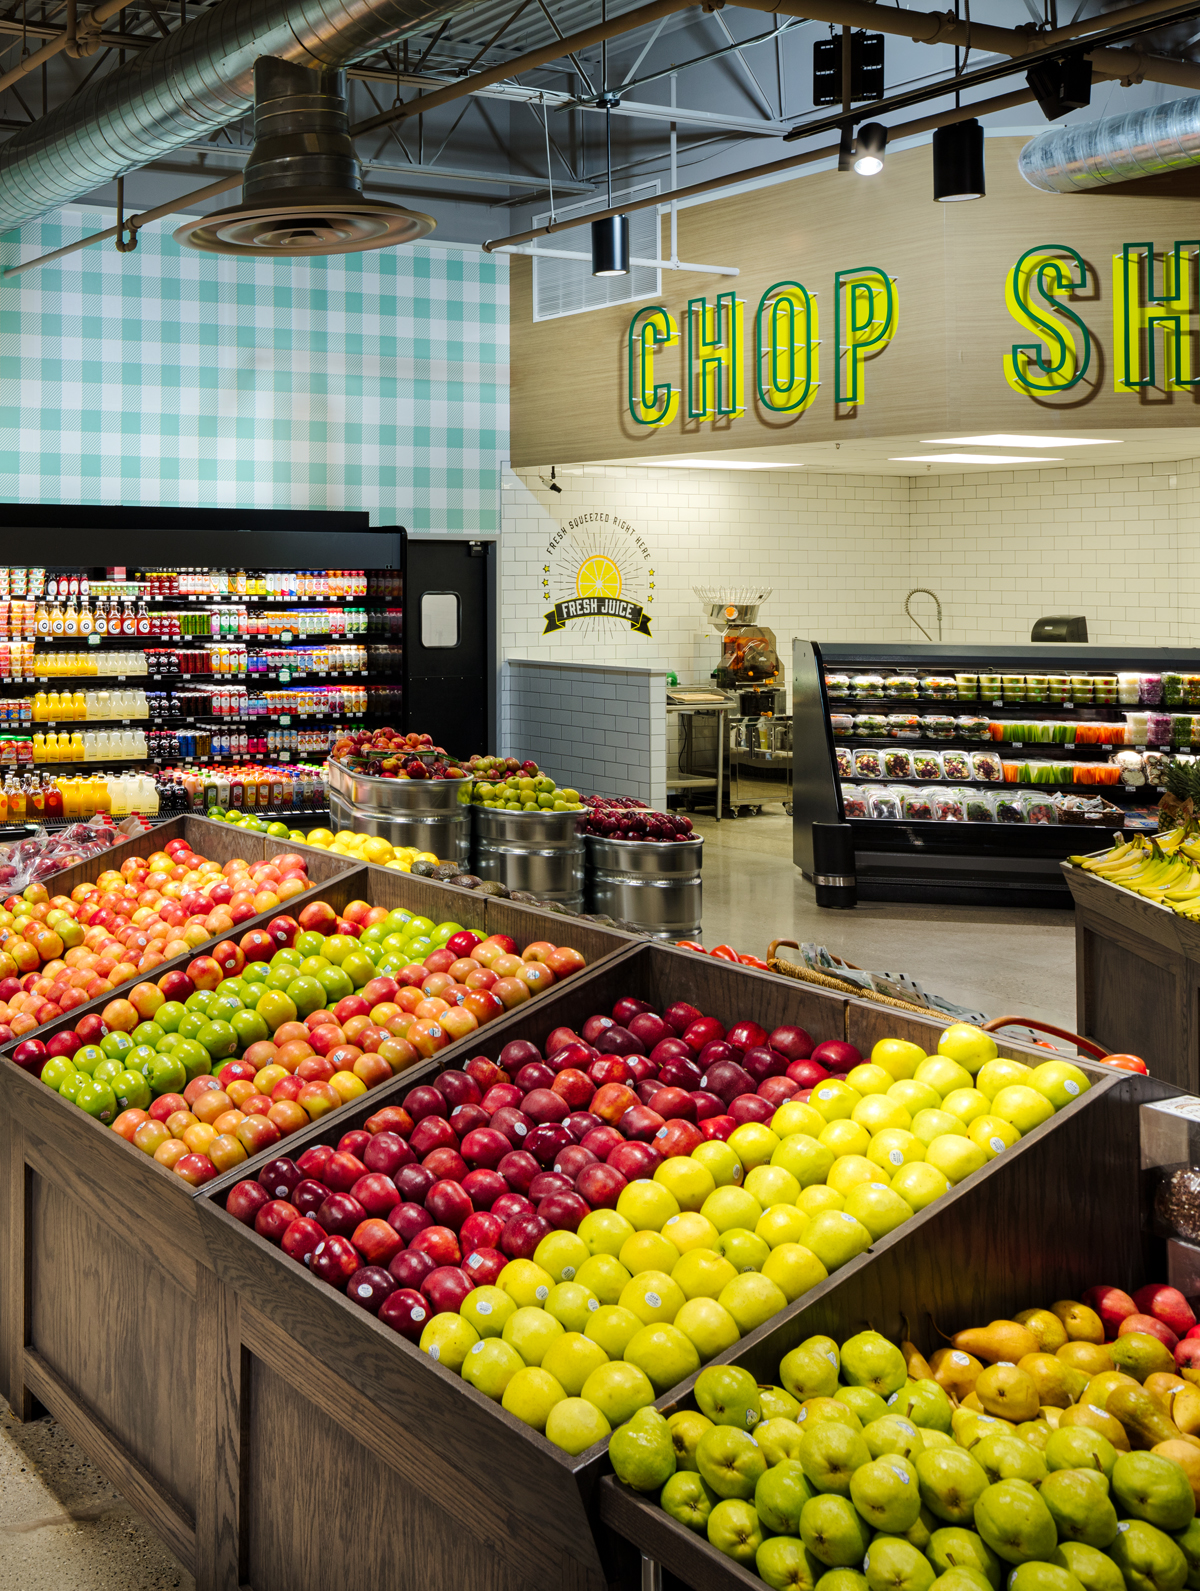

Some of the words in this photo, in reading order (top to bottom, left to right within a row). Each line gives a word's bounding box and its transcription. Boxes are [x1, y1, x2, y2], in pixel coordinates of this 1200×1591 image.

[628, 266, 899, 428] CHOP
[545, 526, 568, 556] FRESH
[568, 512, 610, 530] SQUEEZED
[612, 516, 636, 537] RIGHT
[634, 536, 651, 561] HERE
[561, 598, 598, 618] FRESH
[601, 598, 635, 619] JUICE
